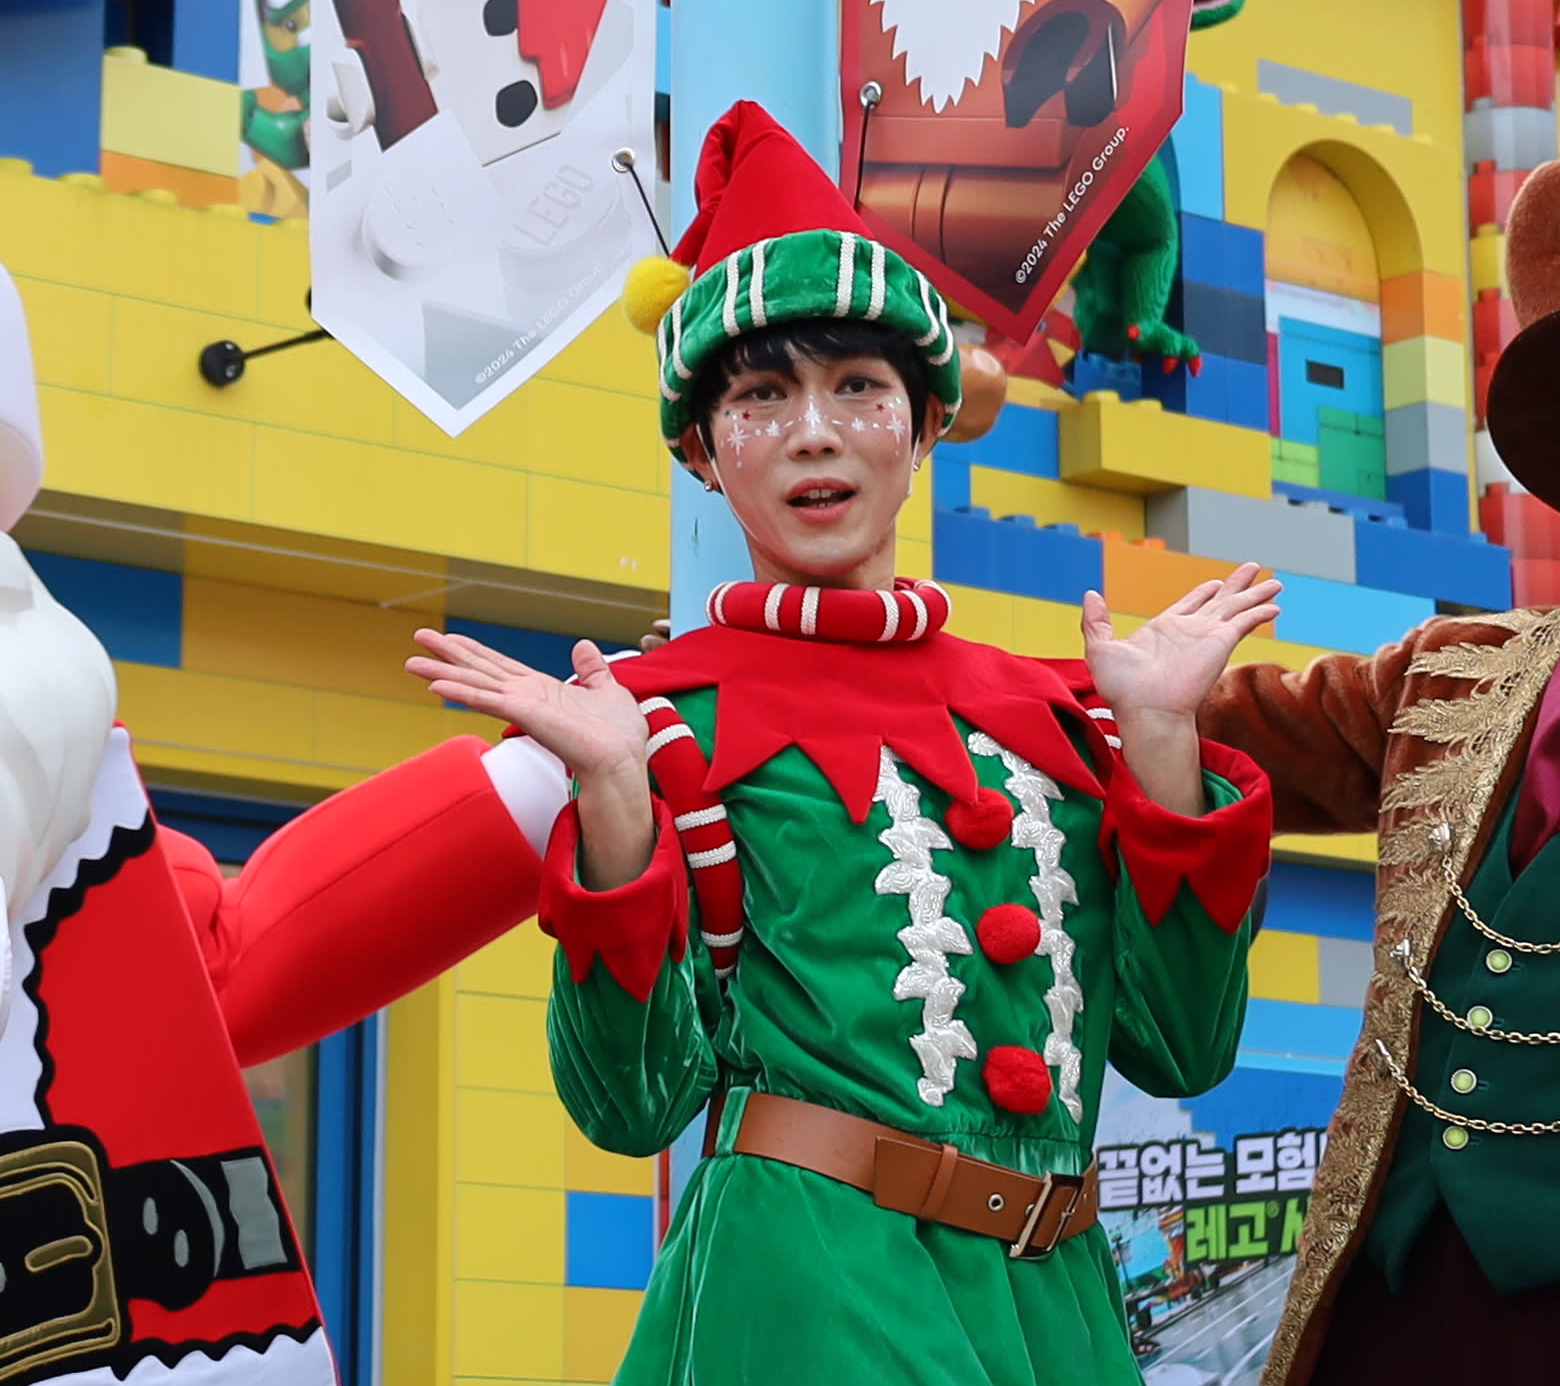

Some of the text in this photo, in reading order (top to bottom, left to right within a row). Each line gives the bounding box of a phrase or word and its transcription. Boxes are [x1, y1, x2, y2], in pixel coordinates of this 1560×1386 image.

[512, 164, 596, 246] LEGO
[1015, 126, 1130, 284] ©2024 The LEGO Group.
[513, 327, 537, 351] The
[536, 297, 569, 330] LEGO
[1097, 1130, 1328, 1209] 끝없는 모험
